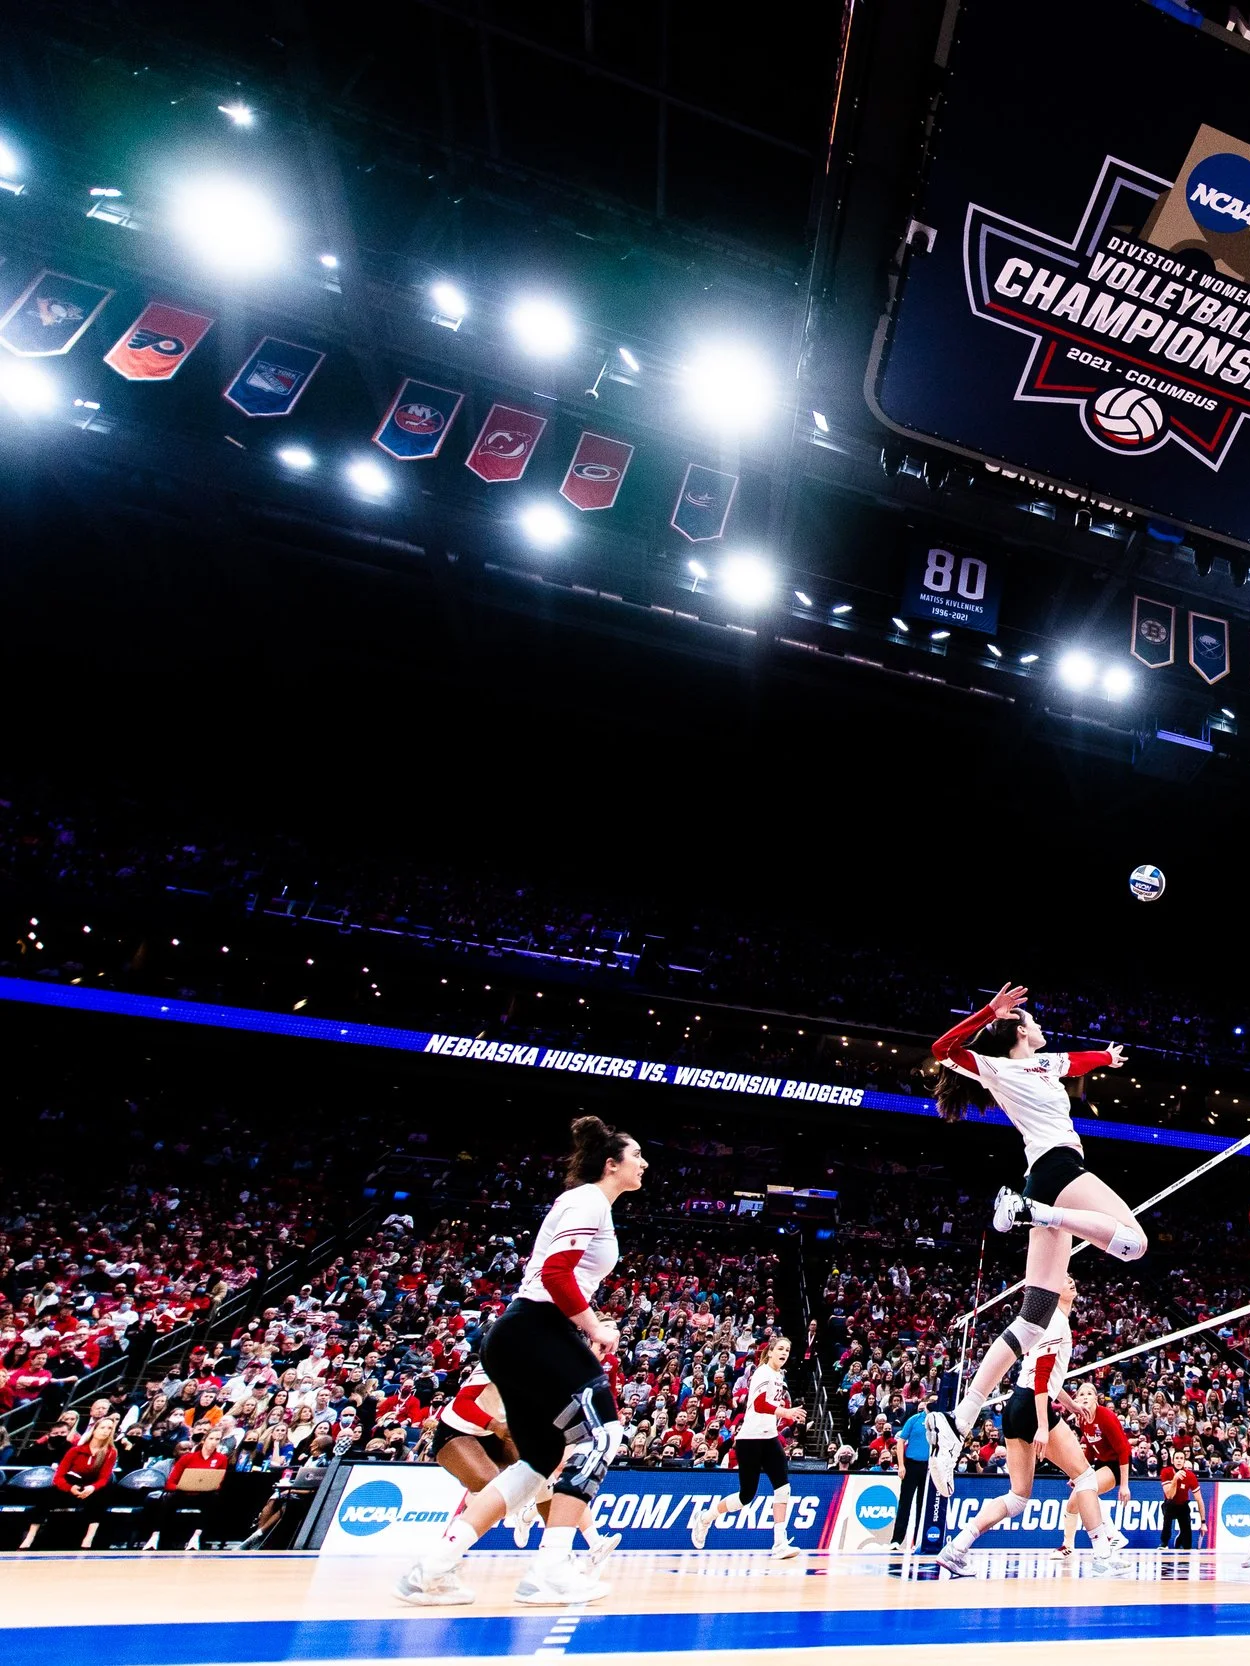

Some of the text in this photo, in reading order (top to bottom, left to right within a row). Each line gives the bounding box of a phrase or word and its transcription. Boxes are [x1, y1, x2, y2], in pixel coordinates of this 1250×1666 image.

[1107, 236, 1185, 277] DIVISION
[1186, 269, 1198, 282] I
[1066, 347, 1112, 373] 2021
[1125, 369, 1218, 411] COLUMBUS
[923, 548, 987, 600] 80
[920, 593, 984, 613] MATISS KIVLENIEKS
[931, 607, 968, 621] 1996-2021
[424, 1034, 865, 1107] NEBRASKA HUSKERS VS. WISCONSIN BADGERS
[341, 1504, 449, 1523] NCAA.com
[859, 1505, 896, 1519] NCAA
